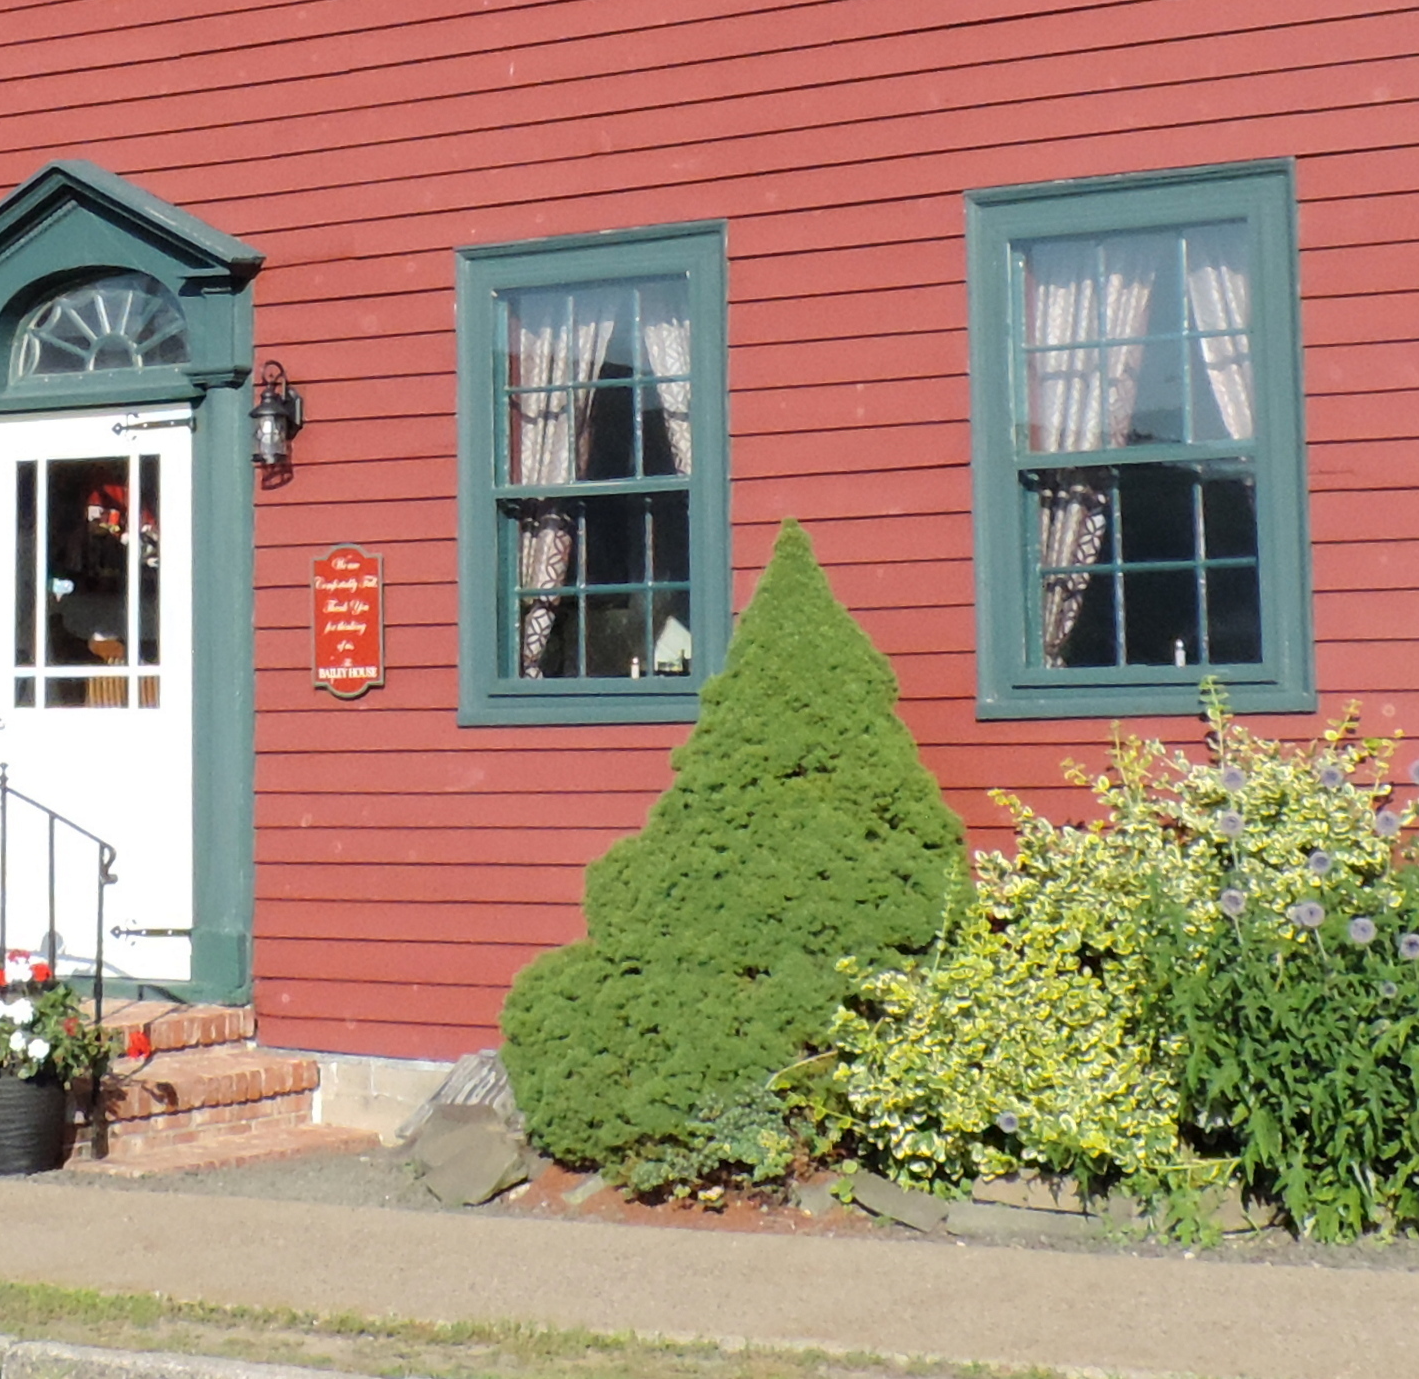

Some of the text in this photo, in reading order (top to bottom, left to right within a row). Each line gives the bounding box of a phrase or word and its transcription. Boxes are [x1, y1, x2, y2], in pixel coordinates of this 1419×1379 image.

[349, 599, 370, 615] You
[318, 666, 378, 679] BAILEY HOUSE
